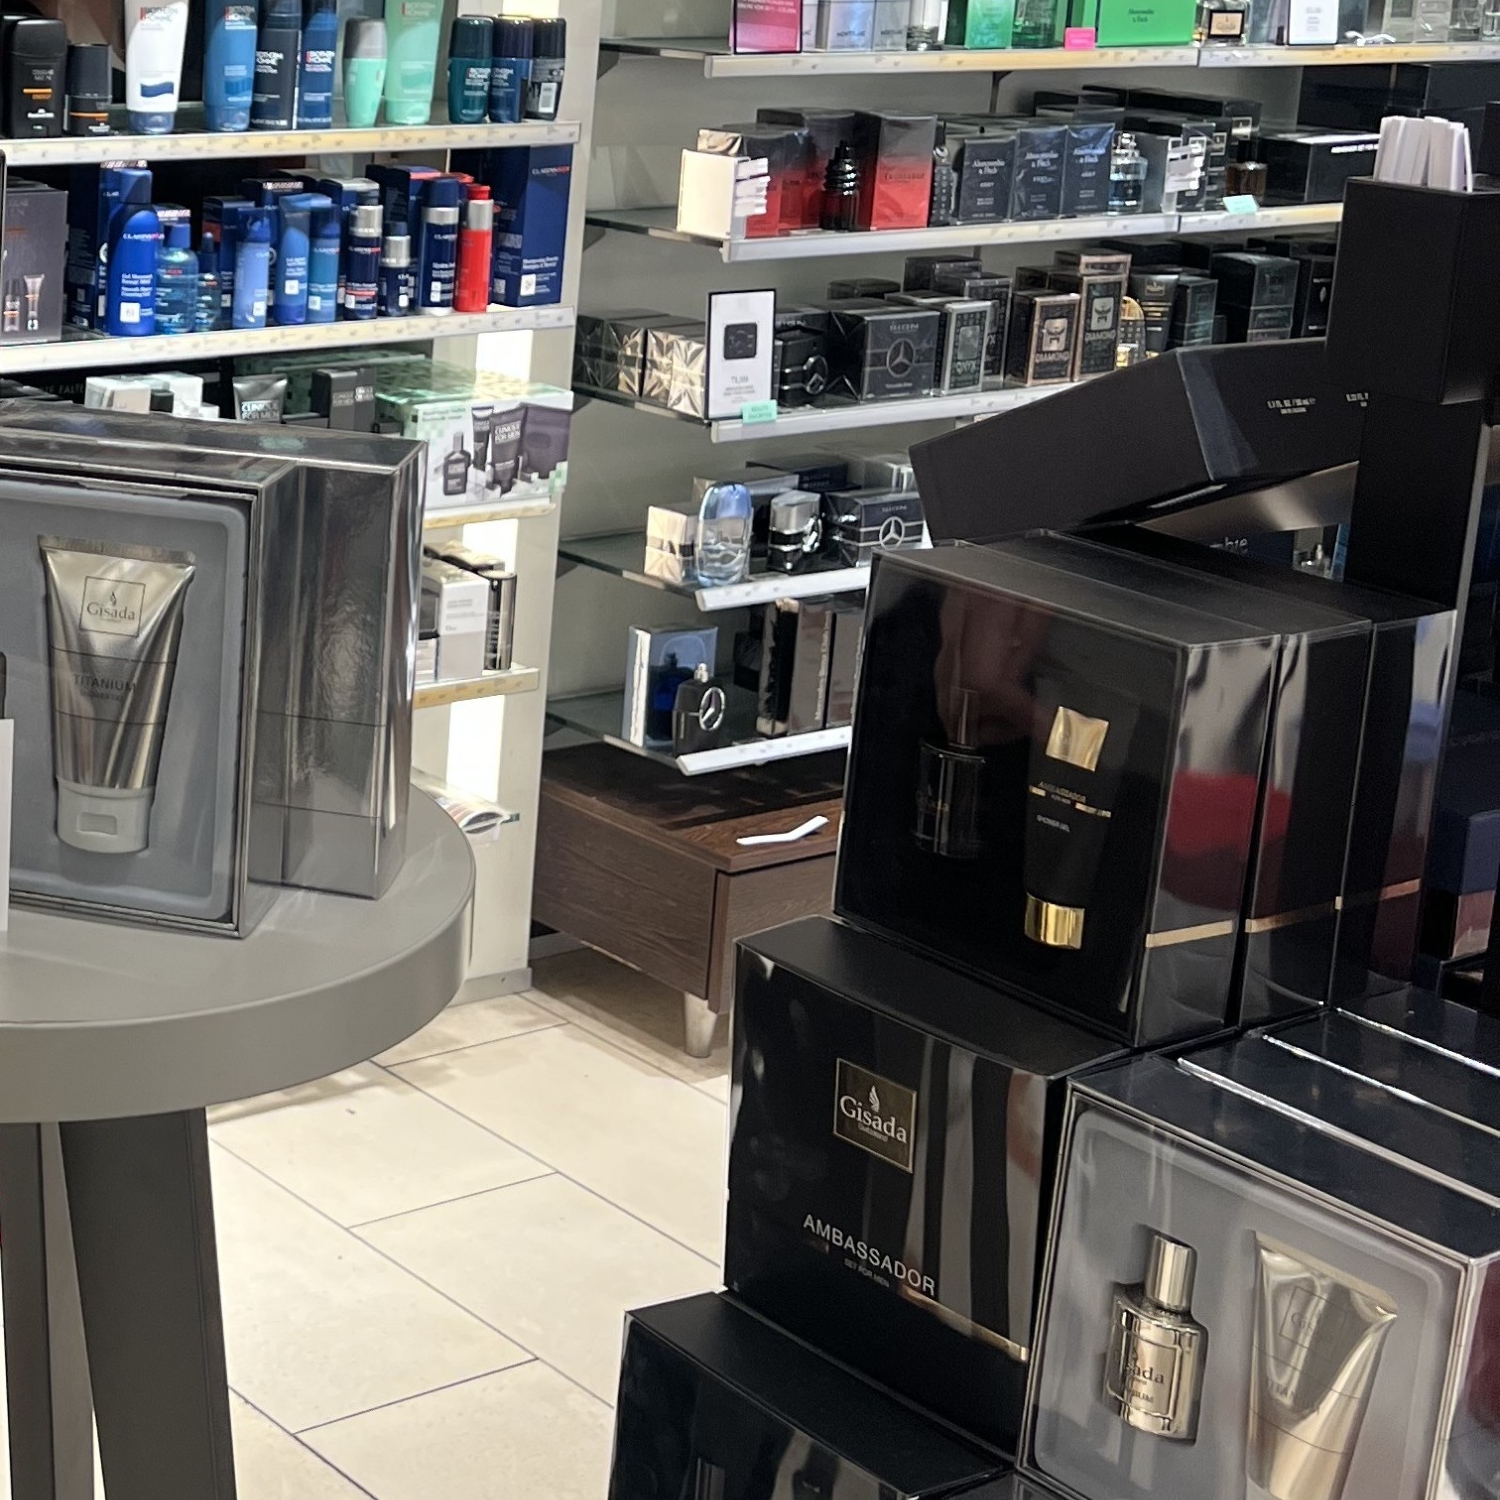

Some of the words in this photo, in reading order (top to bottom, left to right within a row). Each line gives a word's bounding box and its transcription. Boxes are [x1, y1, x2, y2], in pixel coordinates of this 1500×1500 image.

[1085, 330, 1117, 342] DIAMOND
[1035, 349, 1070, 364] DIAMOND
[86, 601, 136, 621] Gisada
[74, 673, 137, 692] TITANIUM
[840, 1095, 908, 1143] Gisada
[803, 1214, 936, 1296] AMBASSADOR
